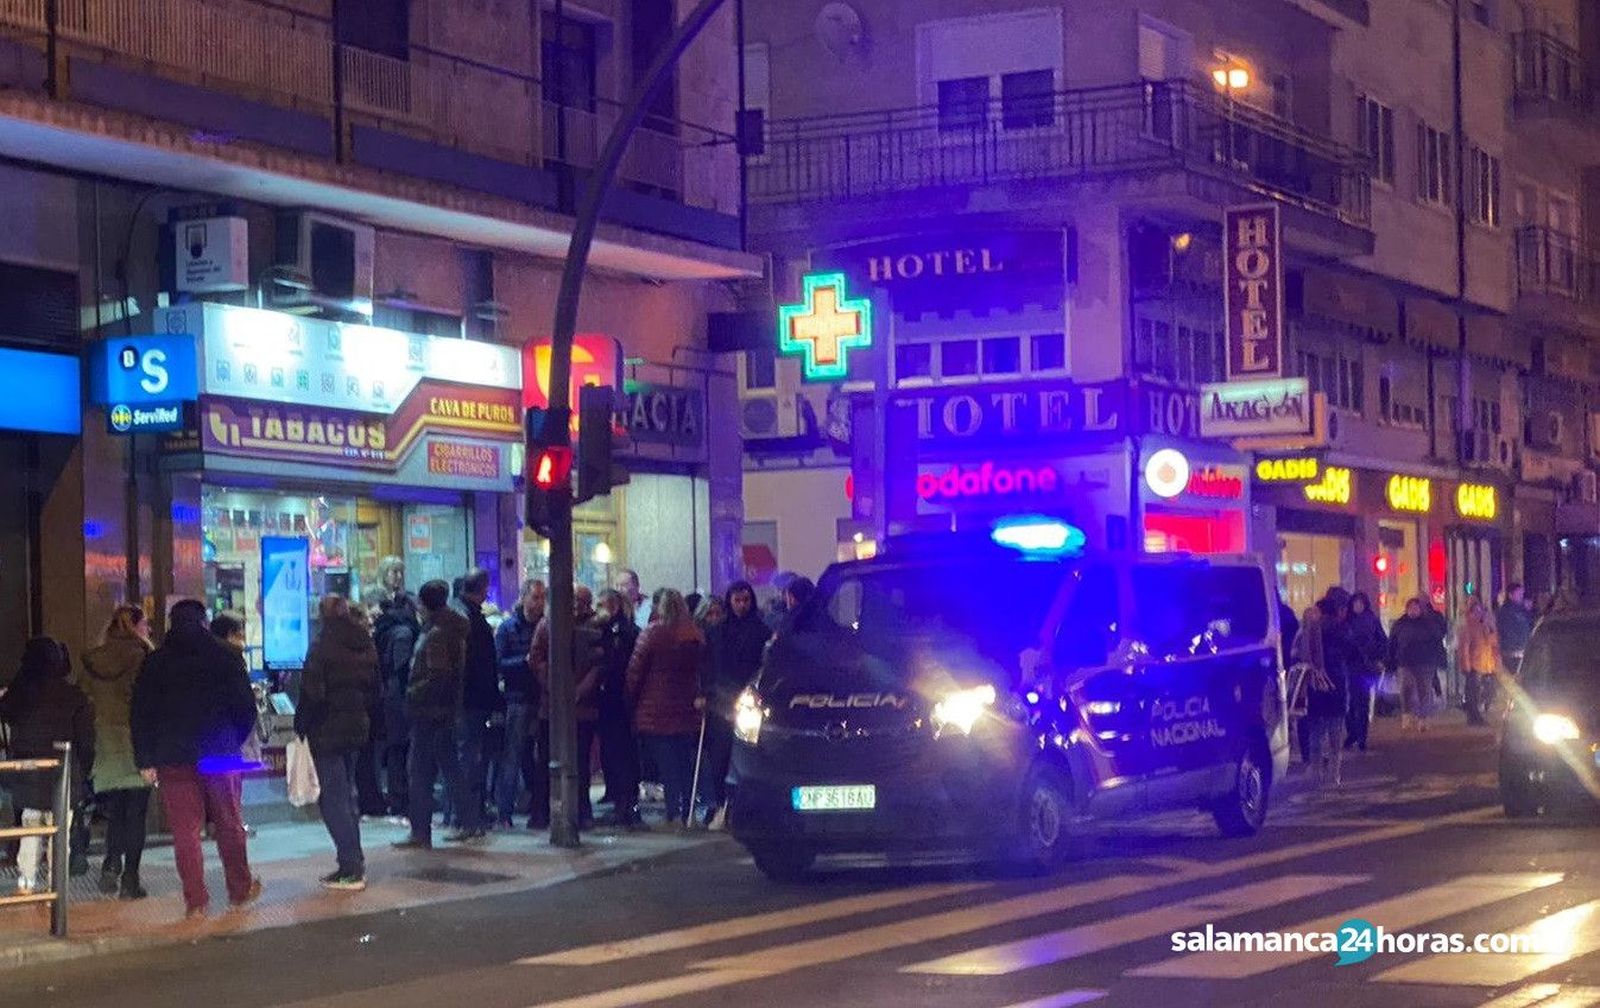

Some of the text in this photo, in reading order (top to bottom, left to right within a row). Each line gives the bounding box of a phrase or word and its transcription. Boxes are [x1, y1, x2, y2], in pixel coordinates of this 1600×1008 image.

[868, 247, 1003, 282] HOTEL
[1235, 216, 1270, 371] HOTEL
[140, 348, 169, 394] S
[133, 406, 178, 425] ServiRed
[430, 397, 516, 423] CAVA DE PUROS
[1148, 390, 1198, 436] HOT
[917, 460, 1056, 501] odafone
[1256, 457, 1319, 481] GADIS
[1150, 717, 1227, 747] NACIONAL
